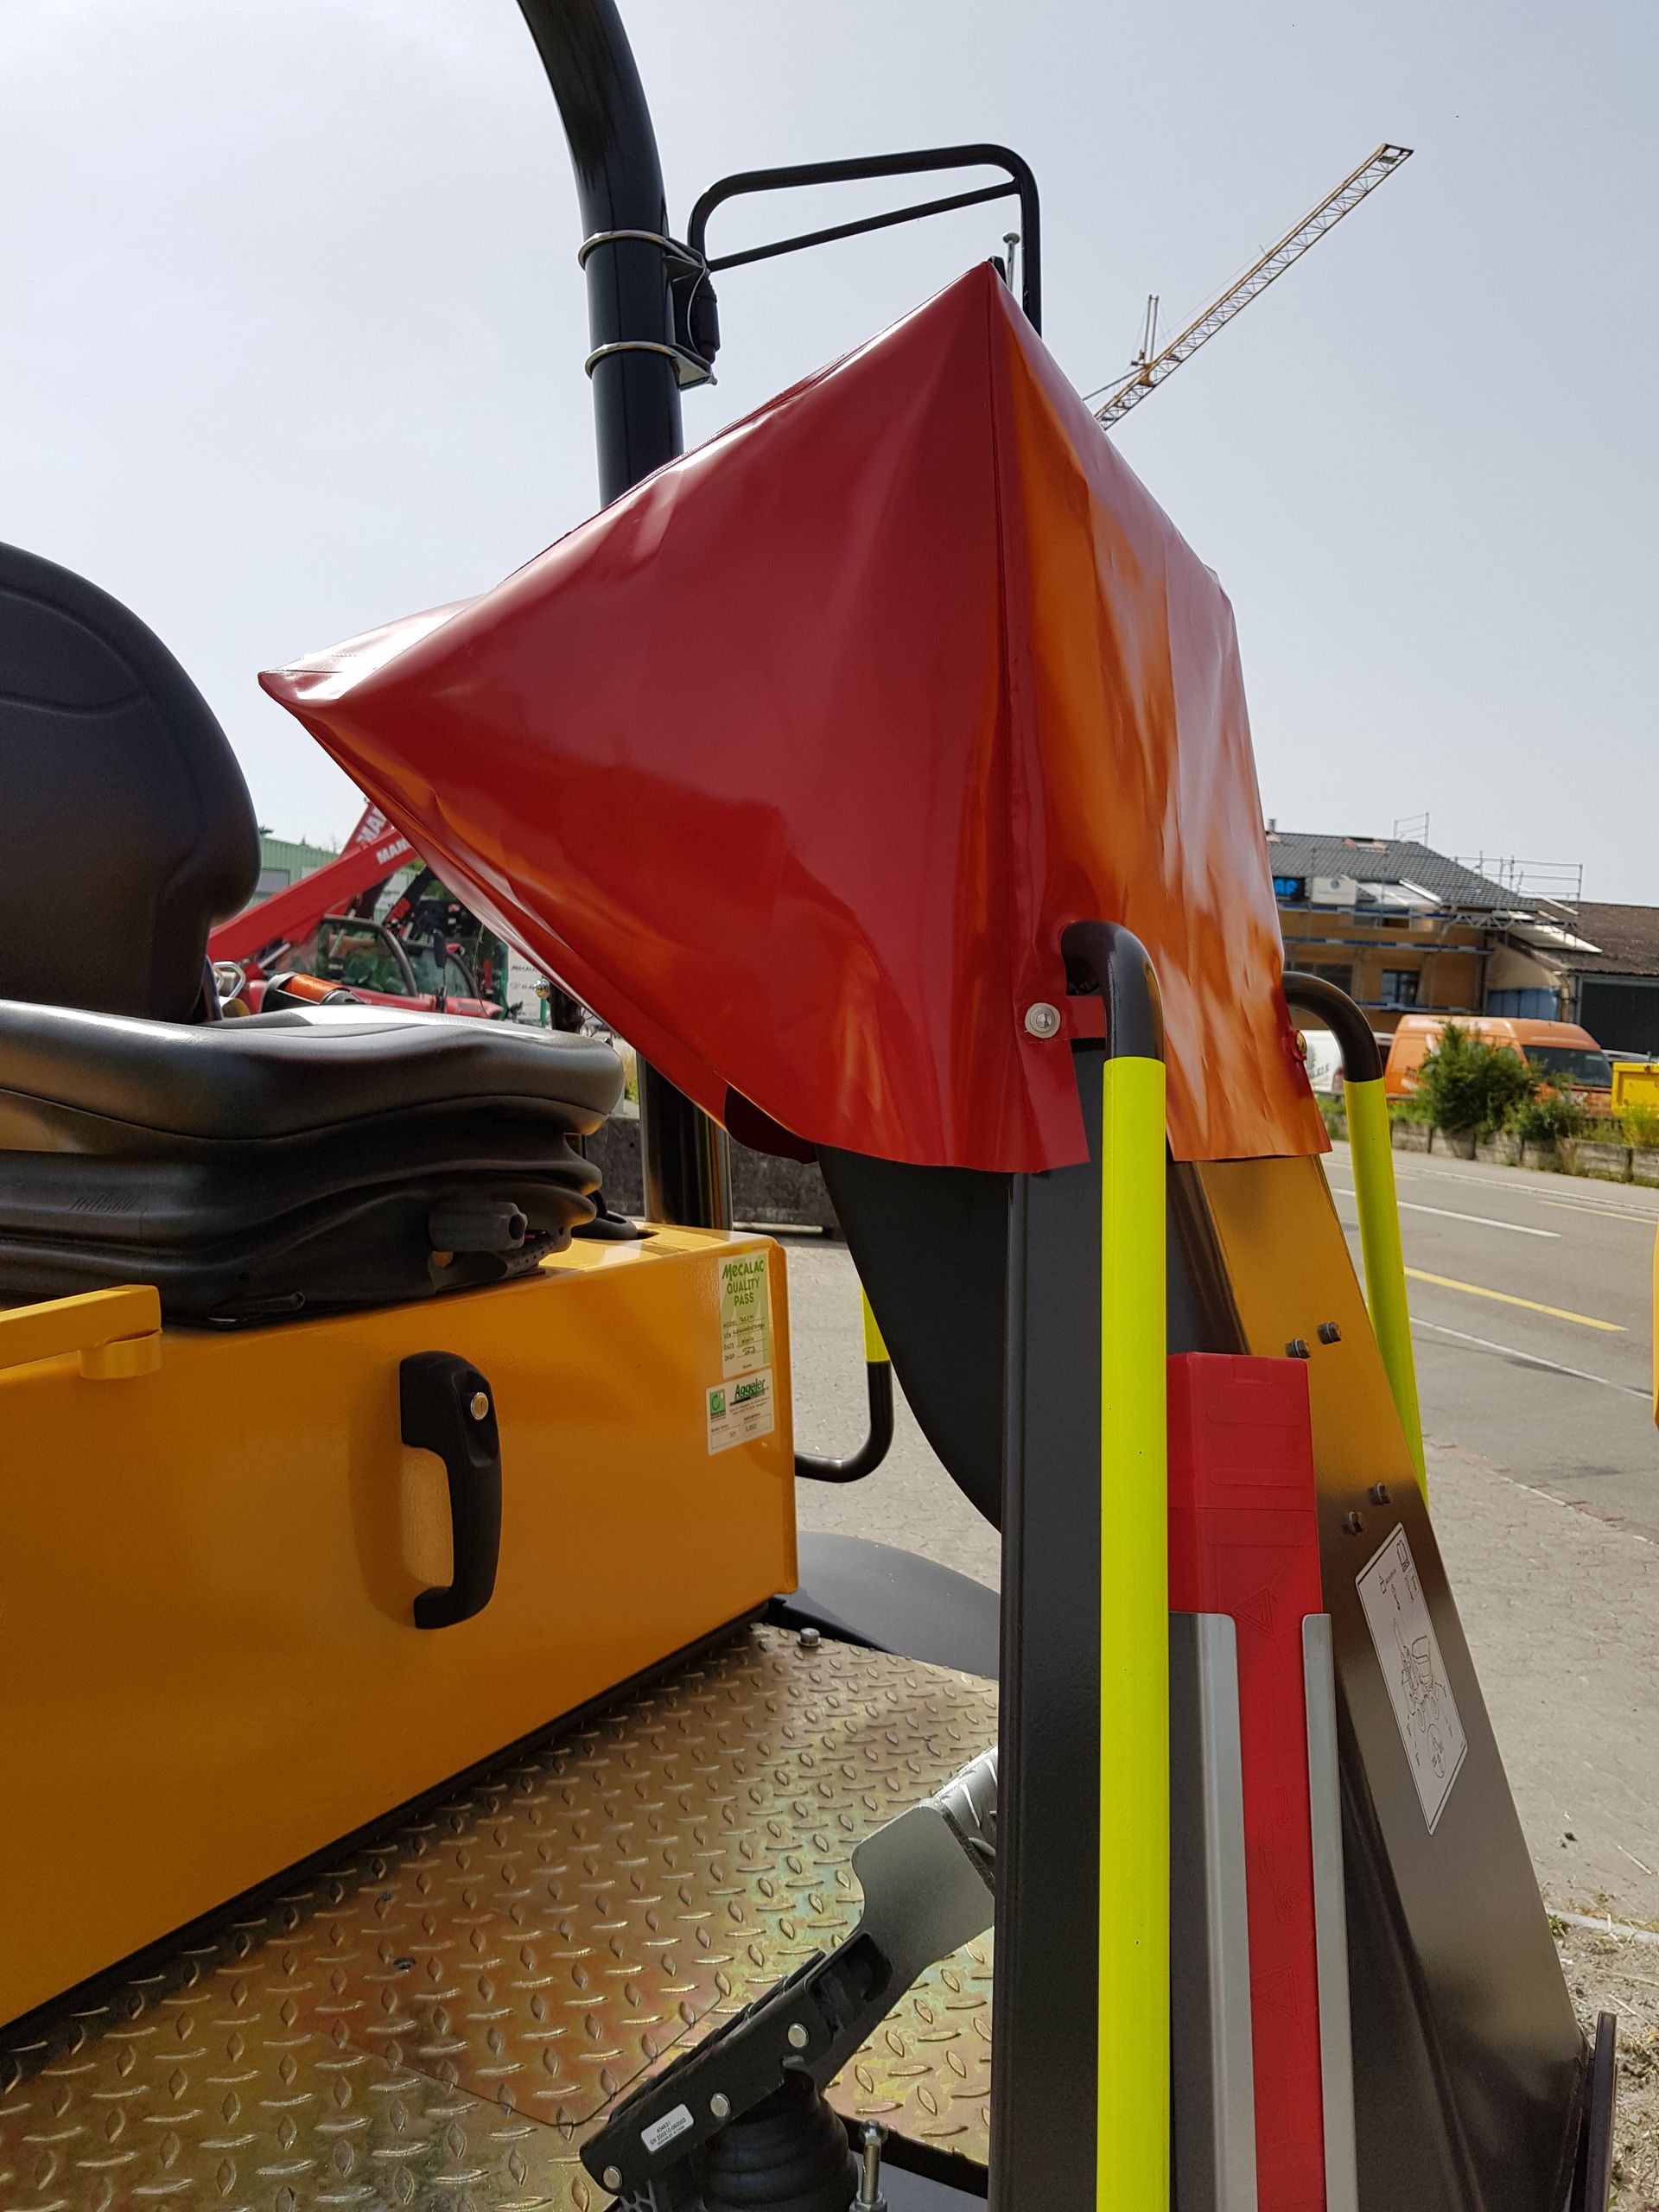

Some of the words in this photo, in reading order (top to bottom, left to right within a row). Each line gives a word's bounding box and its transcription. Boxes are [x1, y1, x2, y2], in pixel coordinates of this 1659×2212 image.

[727, 1277, 760, 1294] QUALITY
[734, 1293, 754, 1306] PASS
[734, 1378, 766, 1399] Aggeler
